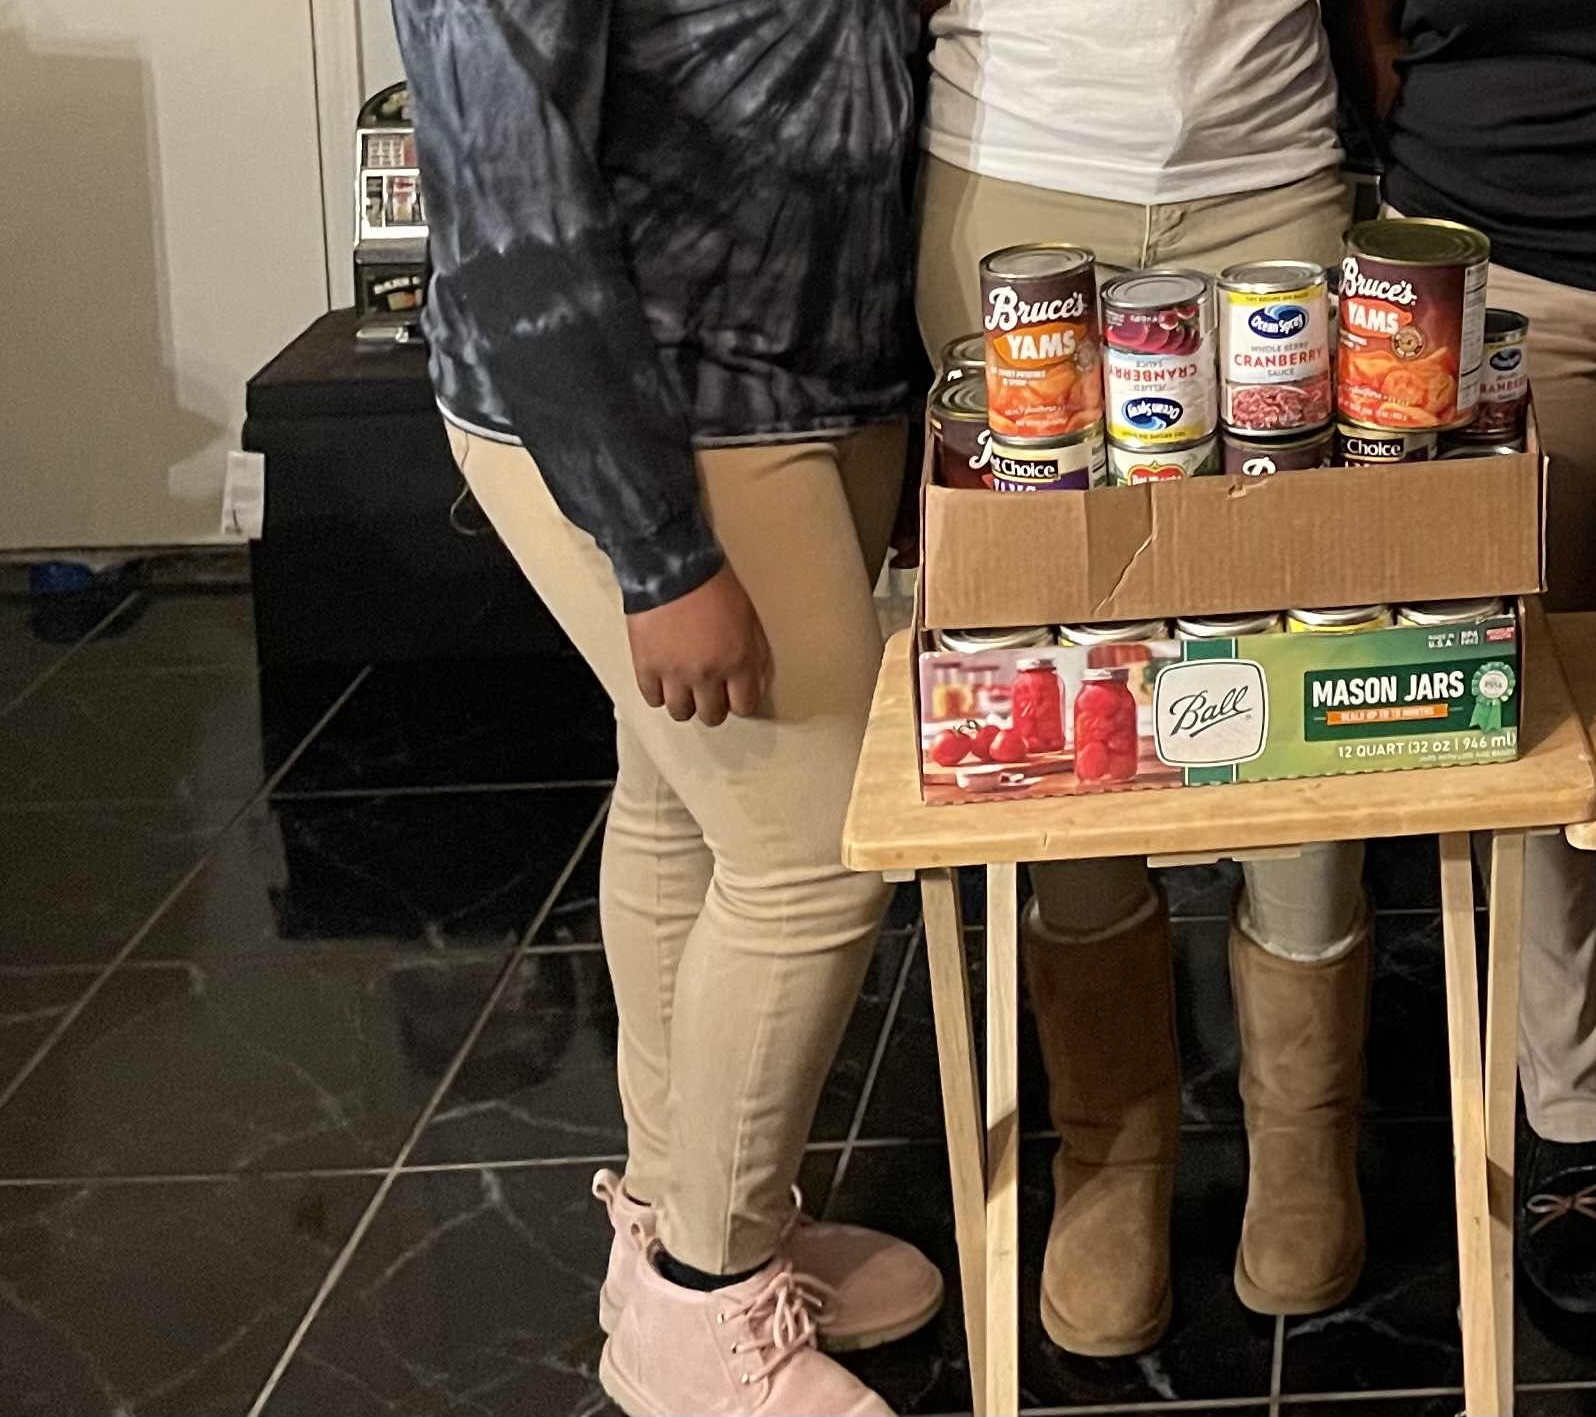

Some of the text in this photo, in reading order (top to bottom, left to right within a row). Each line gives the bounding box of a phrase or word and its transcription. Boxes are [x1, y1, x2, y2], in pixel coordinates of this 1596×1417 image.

[1340, 257, 1417, 305] Bruce's
[984, 285, 1087, 330] Bruce's
[1348, 301, 1399, 333] YAMS
[1005, 330, 1076, 360] YAMS
[1234, 348, 1322, 368] CRANBERRY
[1346, 439, 1401, 457] Choice
[1001, 458, 1056, 478] Choice
[1312, 670, 1465, 708] MASON JARS
[1169, 685, 1252, 738] Ball
[1338, 746, 1352, 758] 12
[1356, 742, 1405, 756] QUART
[1408, 741, 1430, 755] (32
[1463, 736, 1487, 750] 946
[1491, 733, 1516, 747] ml)
